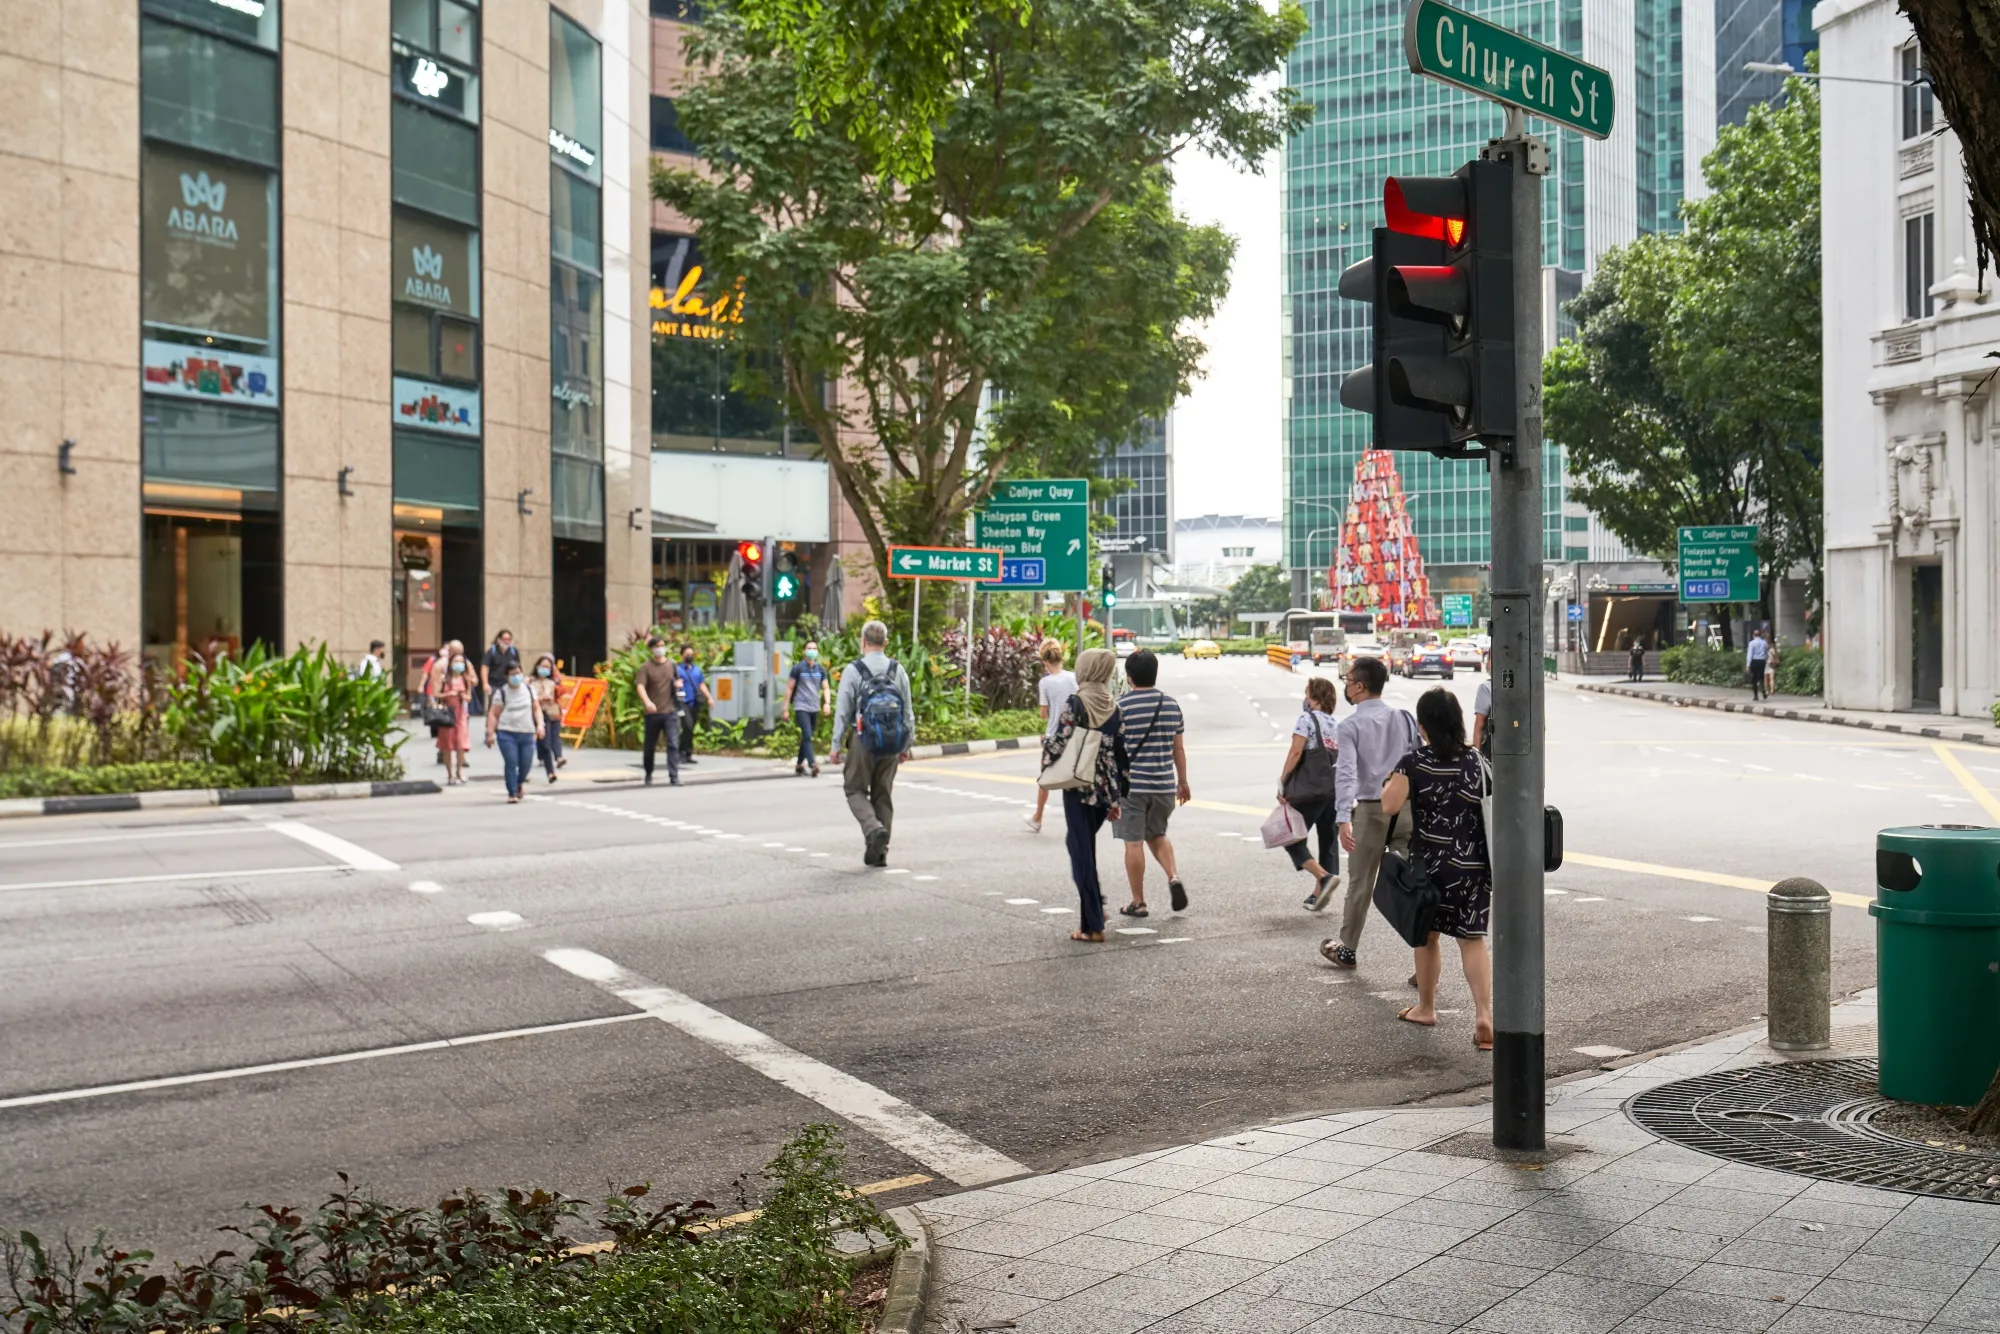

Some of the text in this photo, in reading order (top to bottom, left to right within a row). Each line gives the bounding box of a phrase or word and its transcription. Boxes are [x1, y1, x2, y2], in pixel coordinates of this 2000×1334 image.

[1436, 16, 1599, 125] Church St
[1009, 485, 1074, 500] Collyer Quay
[982, 510, 1061, 525] Finlayson Green
[982, 526, 1046, 541] Shenton Way
[1702, 529, 1748, 540] Collyer Quay
[1021, 541, 1042, 554] Blvd
[1684, 546, 1740, 557] Finlayson Green
[928, 555, 993, 572] Market St
[1684, 557, 1729, 567] Shenton Way
[1002, 564, 1018, 578] CE
[1684, 568, 1727, 577] Marina Blvd
[1688, 584, 1709, 593] MCE
